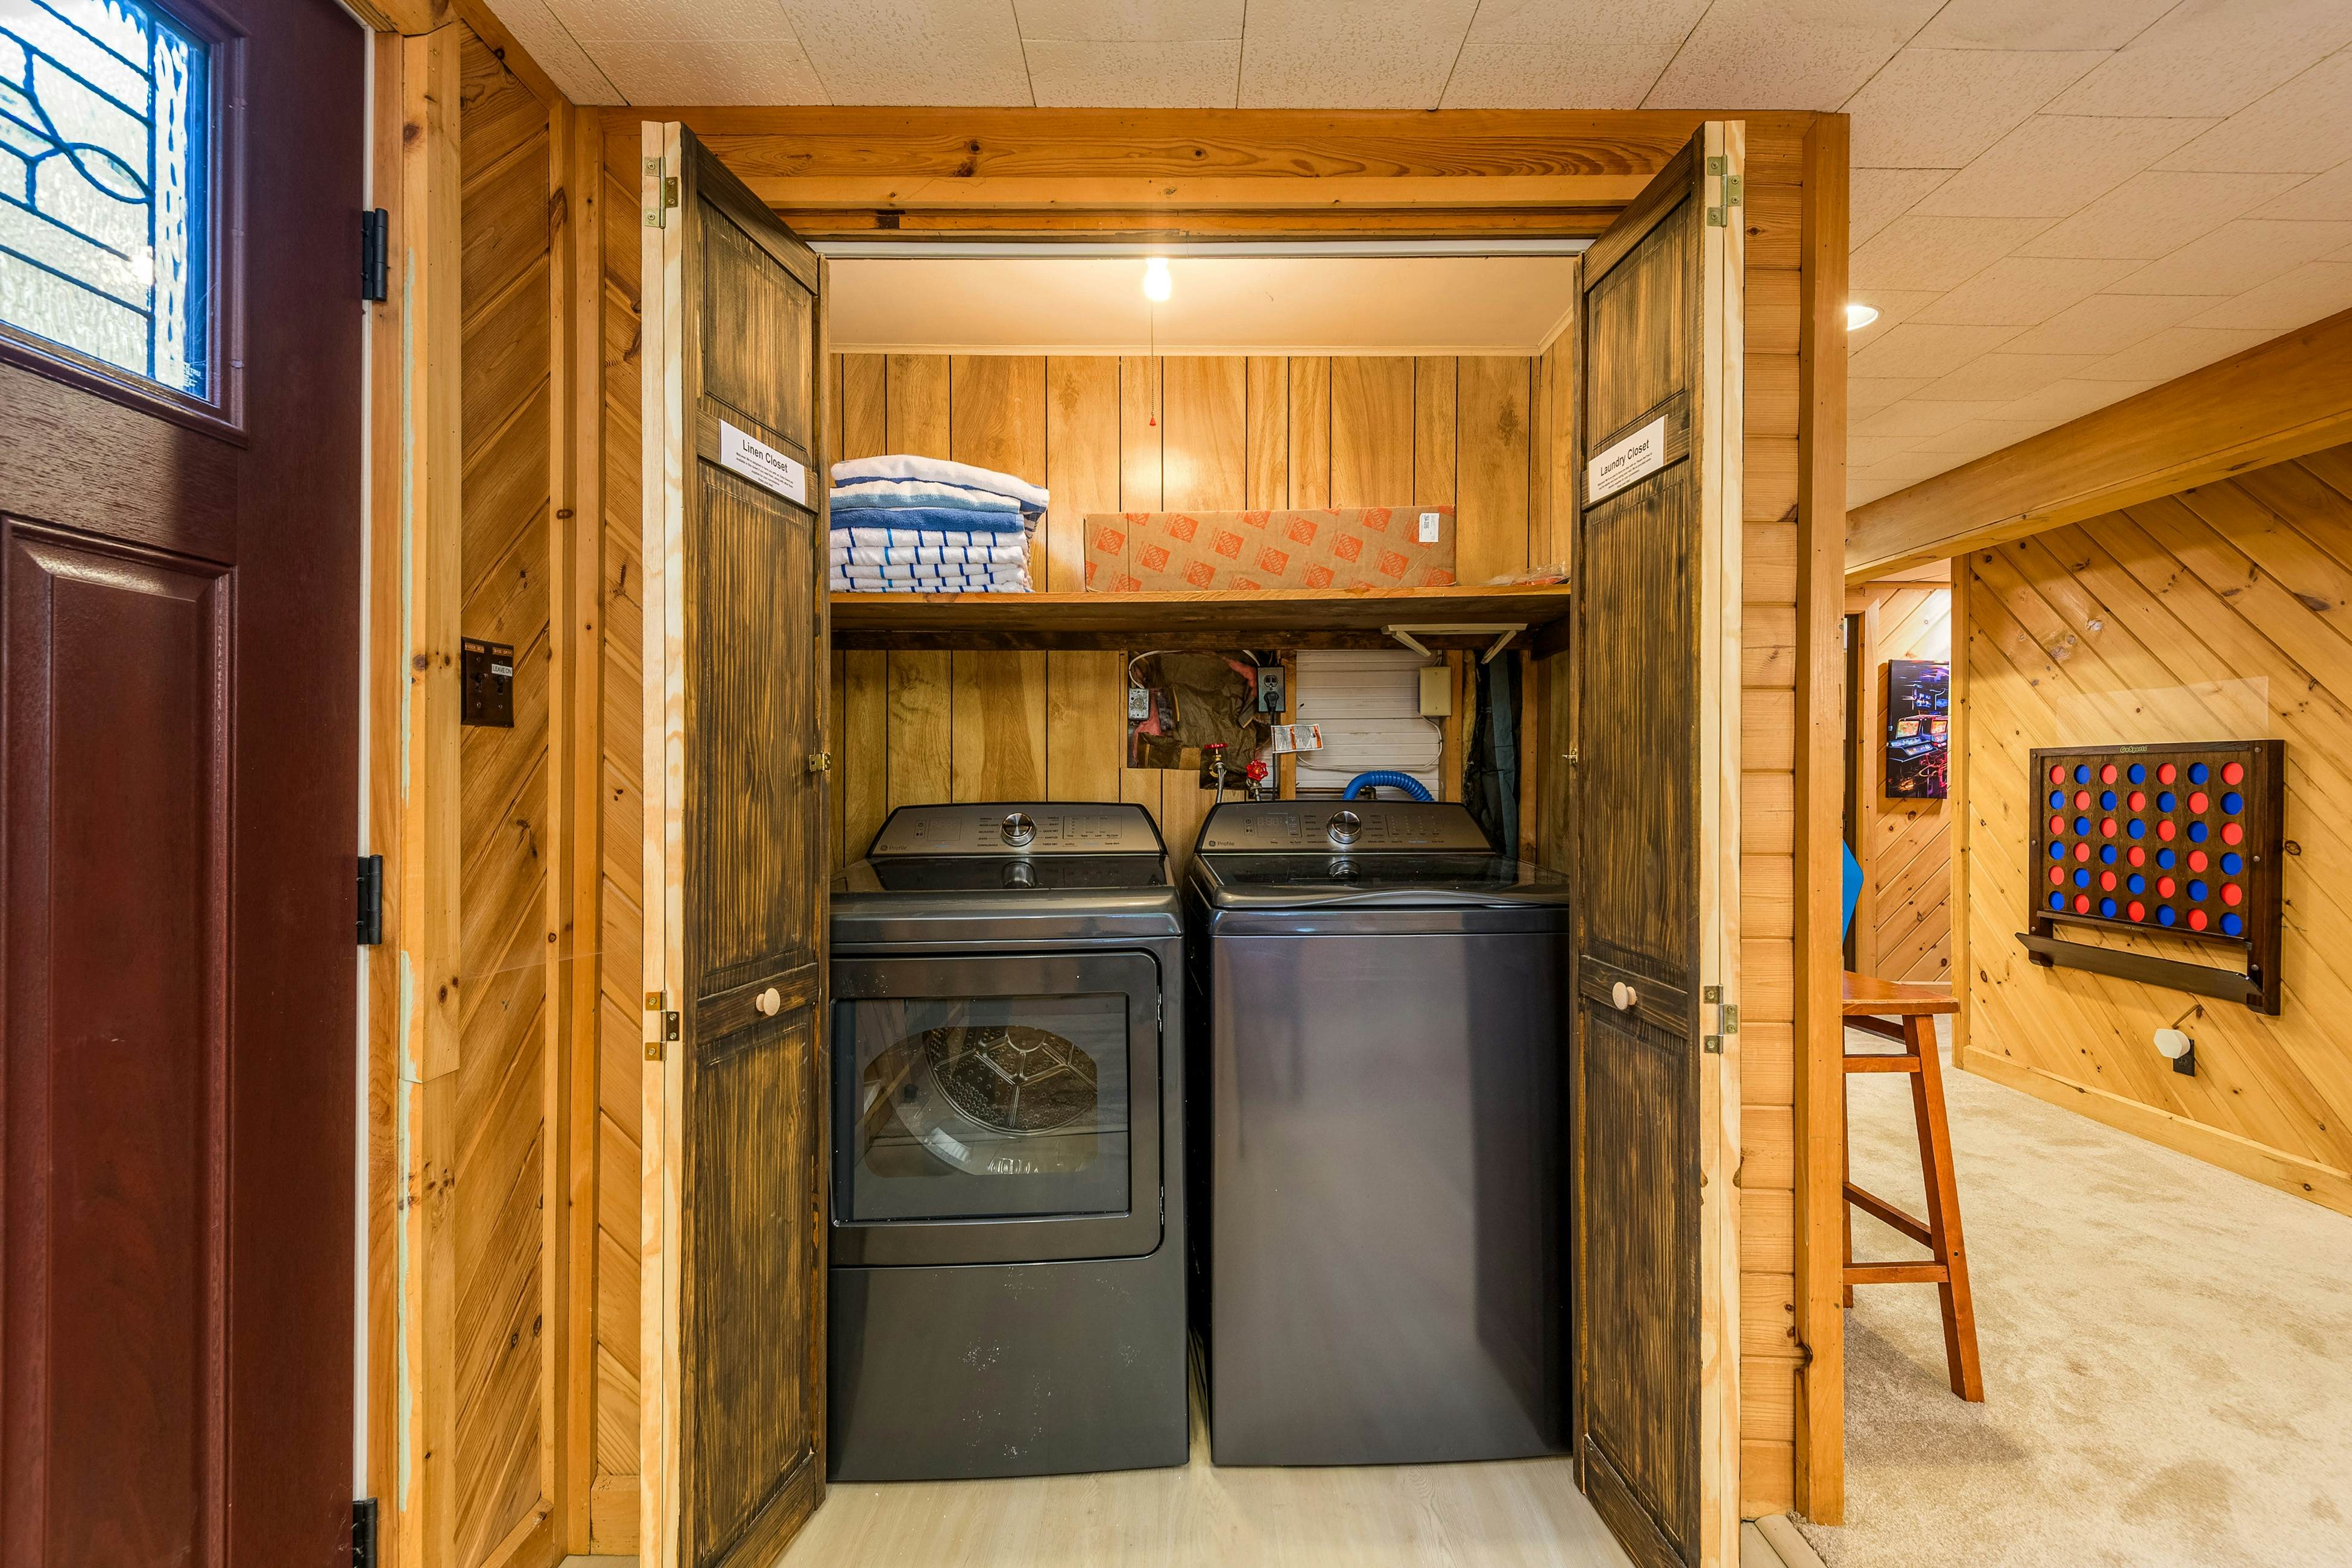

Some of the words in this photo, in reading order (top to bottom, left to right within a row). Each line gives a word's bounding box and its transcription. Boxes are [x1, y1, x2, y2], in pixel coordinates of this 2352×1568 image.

[742, 440, 763, 460] Linen
[765, 452, 788, 473] Closet
[1601, 455, 1626, 476] Laundry
[1628, 439, 1649, 460] Closet
[1102, 528, 1119, 552] HOME
[1175, 515, 1192, 540] HOME
[1294, 518, 1311, 543] HOME
[1220, 532, 1237, 557] HOME
[1339, 535, 1356, 560] HOME
[1146, 545, 1163, 570] HOME
[1265, 548, 1282, 573] HOME
